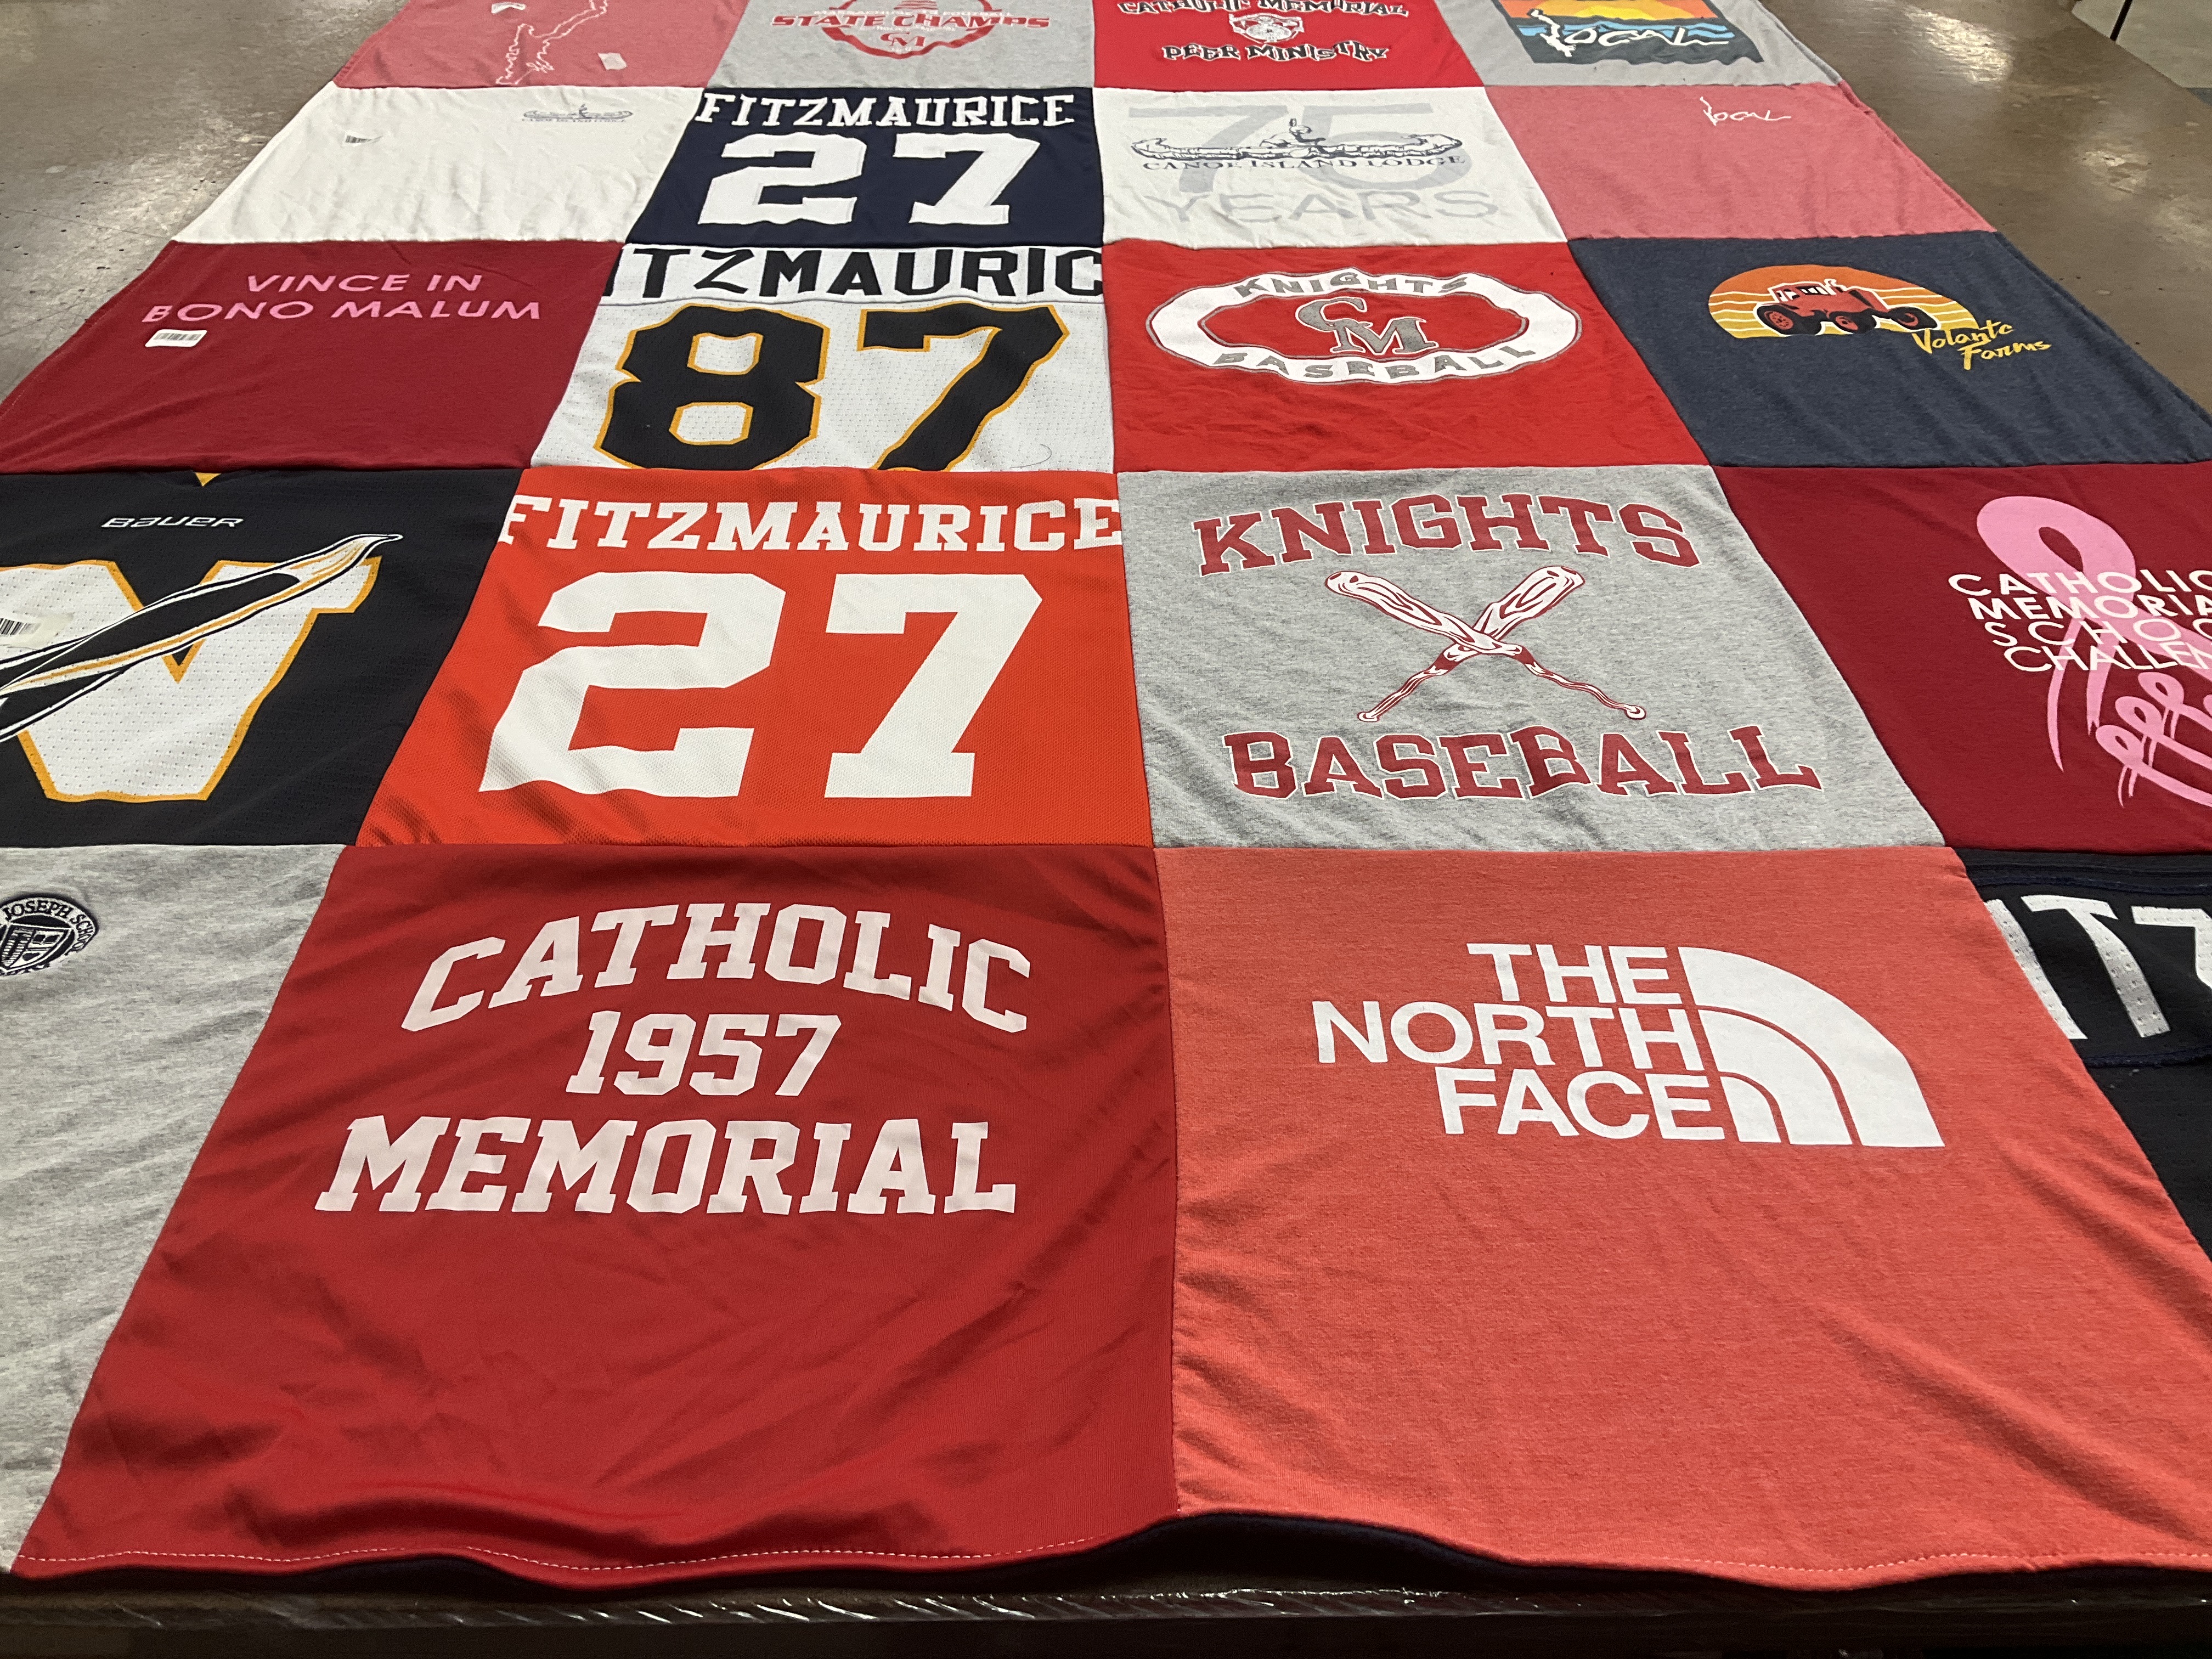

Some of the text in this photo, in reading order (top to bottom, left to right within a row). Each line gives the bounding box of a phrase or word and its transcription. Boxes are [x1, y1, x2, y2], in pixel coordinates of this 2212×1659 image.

[772, 13, 1050, 28] STATE CHAMPS
[1163, 41, 1390, 62] PEER MINISTRY
[695, 93, 1075, 127] FITZMAURICE
[1128, 102, 1473, 193] 75
[1143, 156, 1465, 170] CANOE ISLAND LODGE
[698, 132, 1040, 224] 27
[1143, 190, 1499, 222] YEARS
[246, 273, 482, 292] VINCE IN
[1234, 272, 1468, 297] KNIGHTS
[142, 301, 541, 323] BONO MALUM
[1295, 297, 1438, 355] CM
[1911, 320, 2014, 354] Volante
[1212, 345, 1537, 380] BASEBALL
[1957, 340, 2052, 370] Farms
[593, 301, 1070, 472] 87
[498, 494, 1122, 553] FITZMAURICE
[1191, 493, 1702, 577] KNIGHTS
[478, 571, 1043, 799] 27
[1222, 725, 1824, 800] BASEBALL
[3, 900, 74, 921] JOSEPH
[400, 902, 1031, 1033] CATHOLIC
[1466, 943, 1683, 1006] THE
[565, 1010, 842, 1097] 1957
[1312, 1000, 1704, 1071] NORTH
[1434, 1065, 1725, 1141] FACE
[314, 1115, 1017, 1215] MEMORIAL
